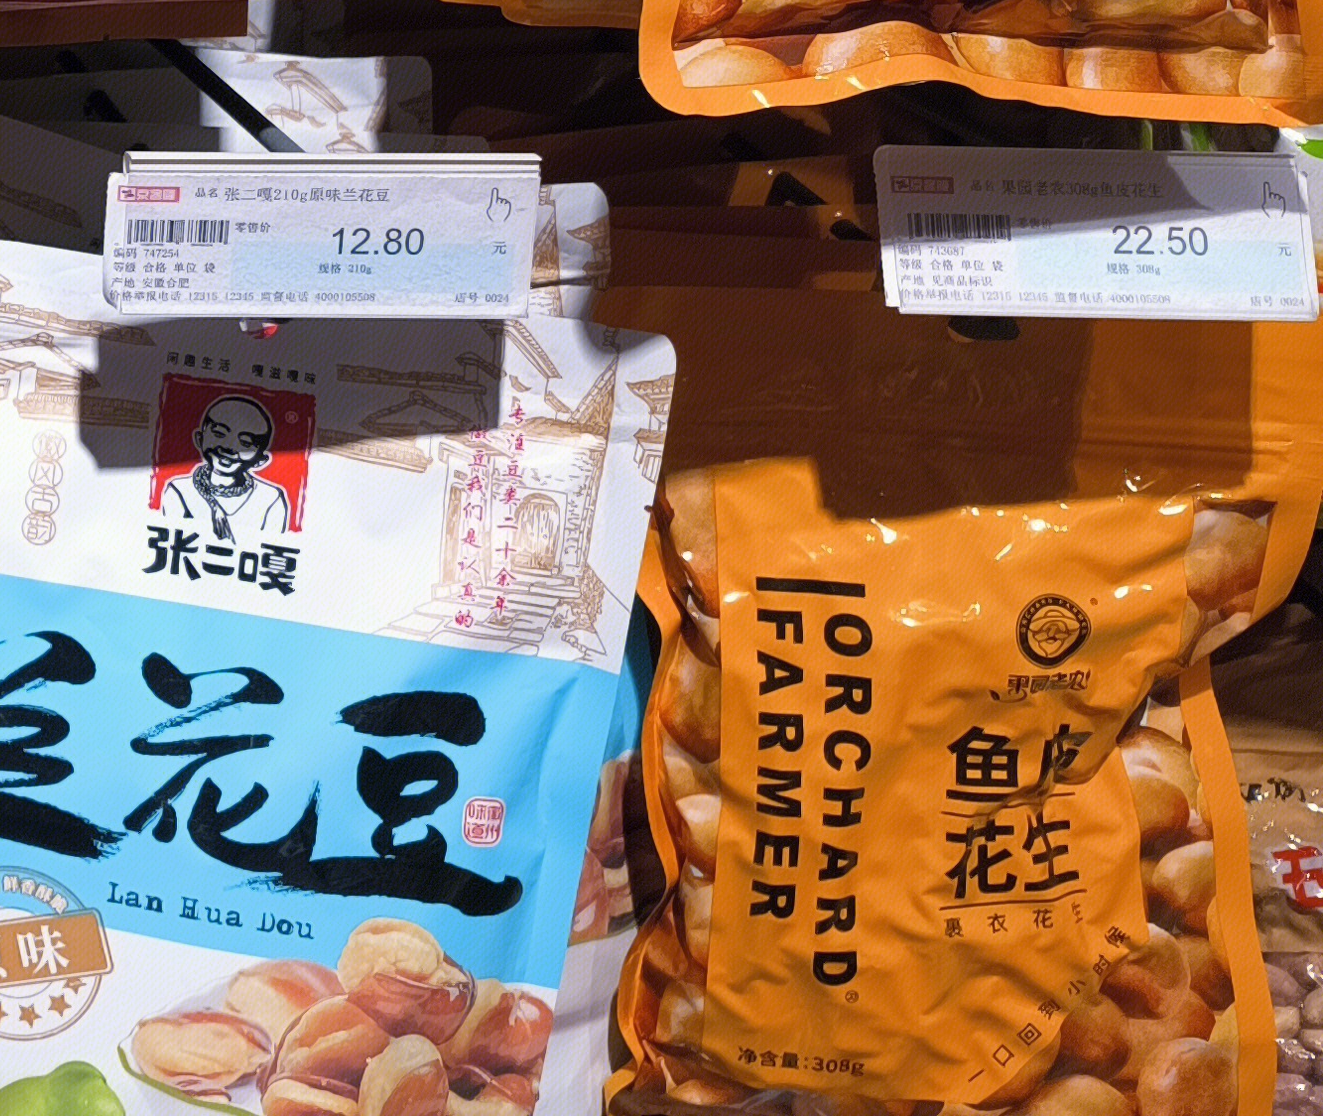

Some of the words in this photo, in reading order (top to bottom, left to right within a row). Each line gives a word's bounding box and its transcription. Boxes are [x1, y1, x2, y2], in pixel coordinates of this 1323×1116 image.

[195, 188, 218, 198] 品名
[224, 186, 389, 204] 张二嘎210g原味兰花豆
[143, 248, 179, 258] 747254
[332, 227, 425, 255] 12.80
[492, 241, 507, 255] 元
[1112, 225, 1209, 257] 22.50
[1278, 244, 1292, 257] 元
[143, 262, 166, 273] 合格
[174, 263, 196, 273] 单位
[348, 264, 372, 275] 210g
[930, 259, 954, 270] 合格
[961, 260, 984, 270] 单位
[1136, 264, 1161, 276] 308g
[109, 291, 181, 302] 价格举报电话
[188, 292, 217, 302] 12315
[224, 292, 254, 302] 12345
[260, 291, 308, 302] 监督电话
[315, 292, 375, 302] 4000105508
[142, 278, 190, 289] 安徽合肥
[485, 293, 509, 303] 0024
[1280, 297, 1305, 307] 0024
[490, 405, 525, 616] 专注豆类二十余年
[455, 425, 489, 628] 做豆我们是认真的
[142, 526, 300, 596] 张二嘎
[749, 610, 804, 920] FARMER
[947, 725, 1092, 801] 鱼皮
[813, 615, 872, 986] ORCHARD
[945, 815, 1080, 898] 花生
[108, 882, 163, 915] Lan
[181, 896, 243, 928] Hua
[258, 911, 314, 940] Dou
[944, 902, 1085, 938] 裹衣花生
[968, 926, 1132, 1083] 一口回到小时候
[738, 1047, 865, 1076] 净含量:308g
